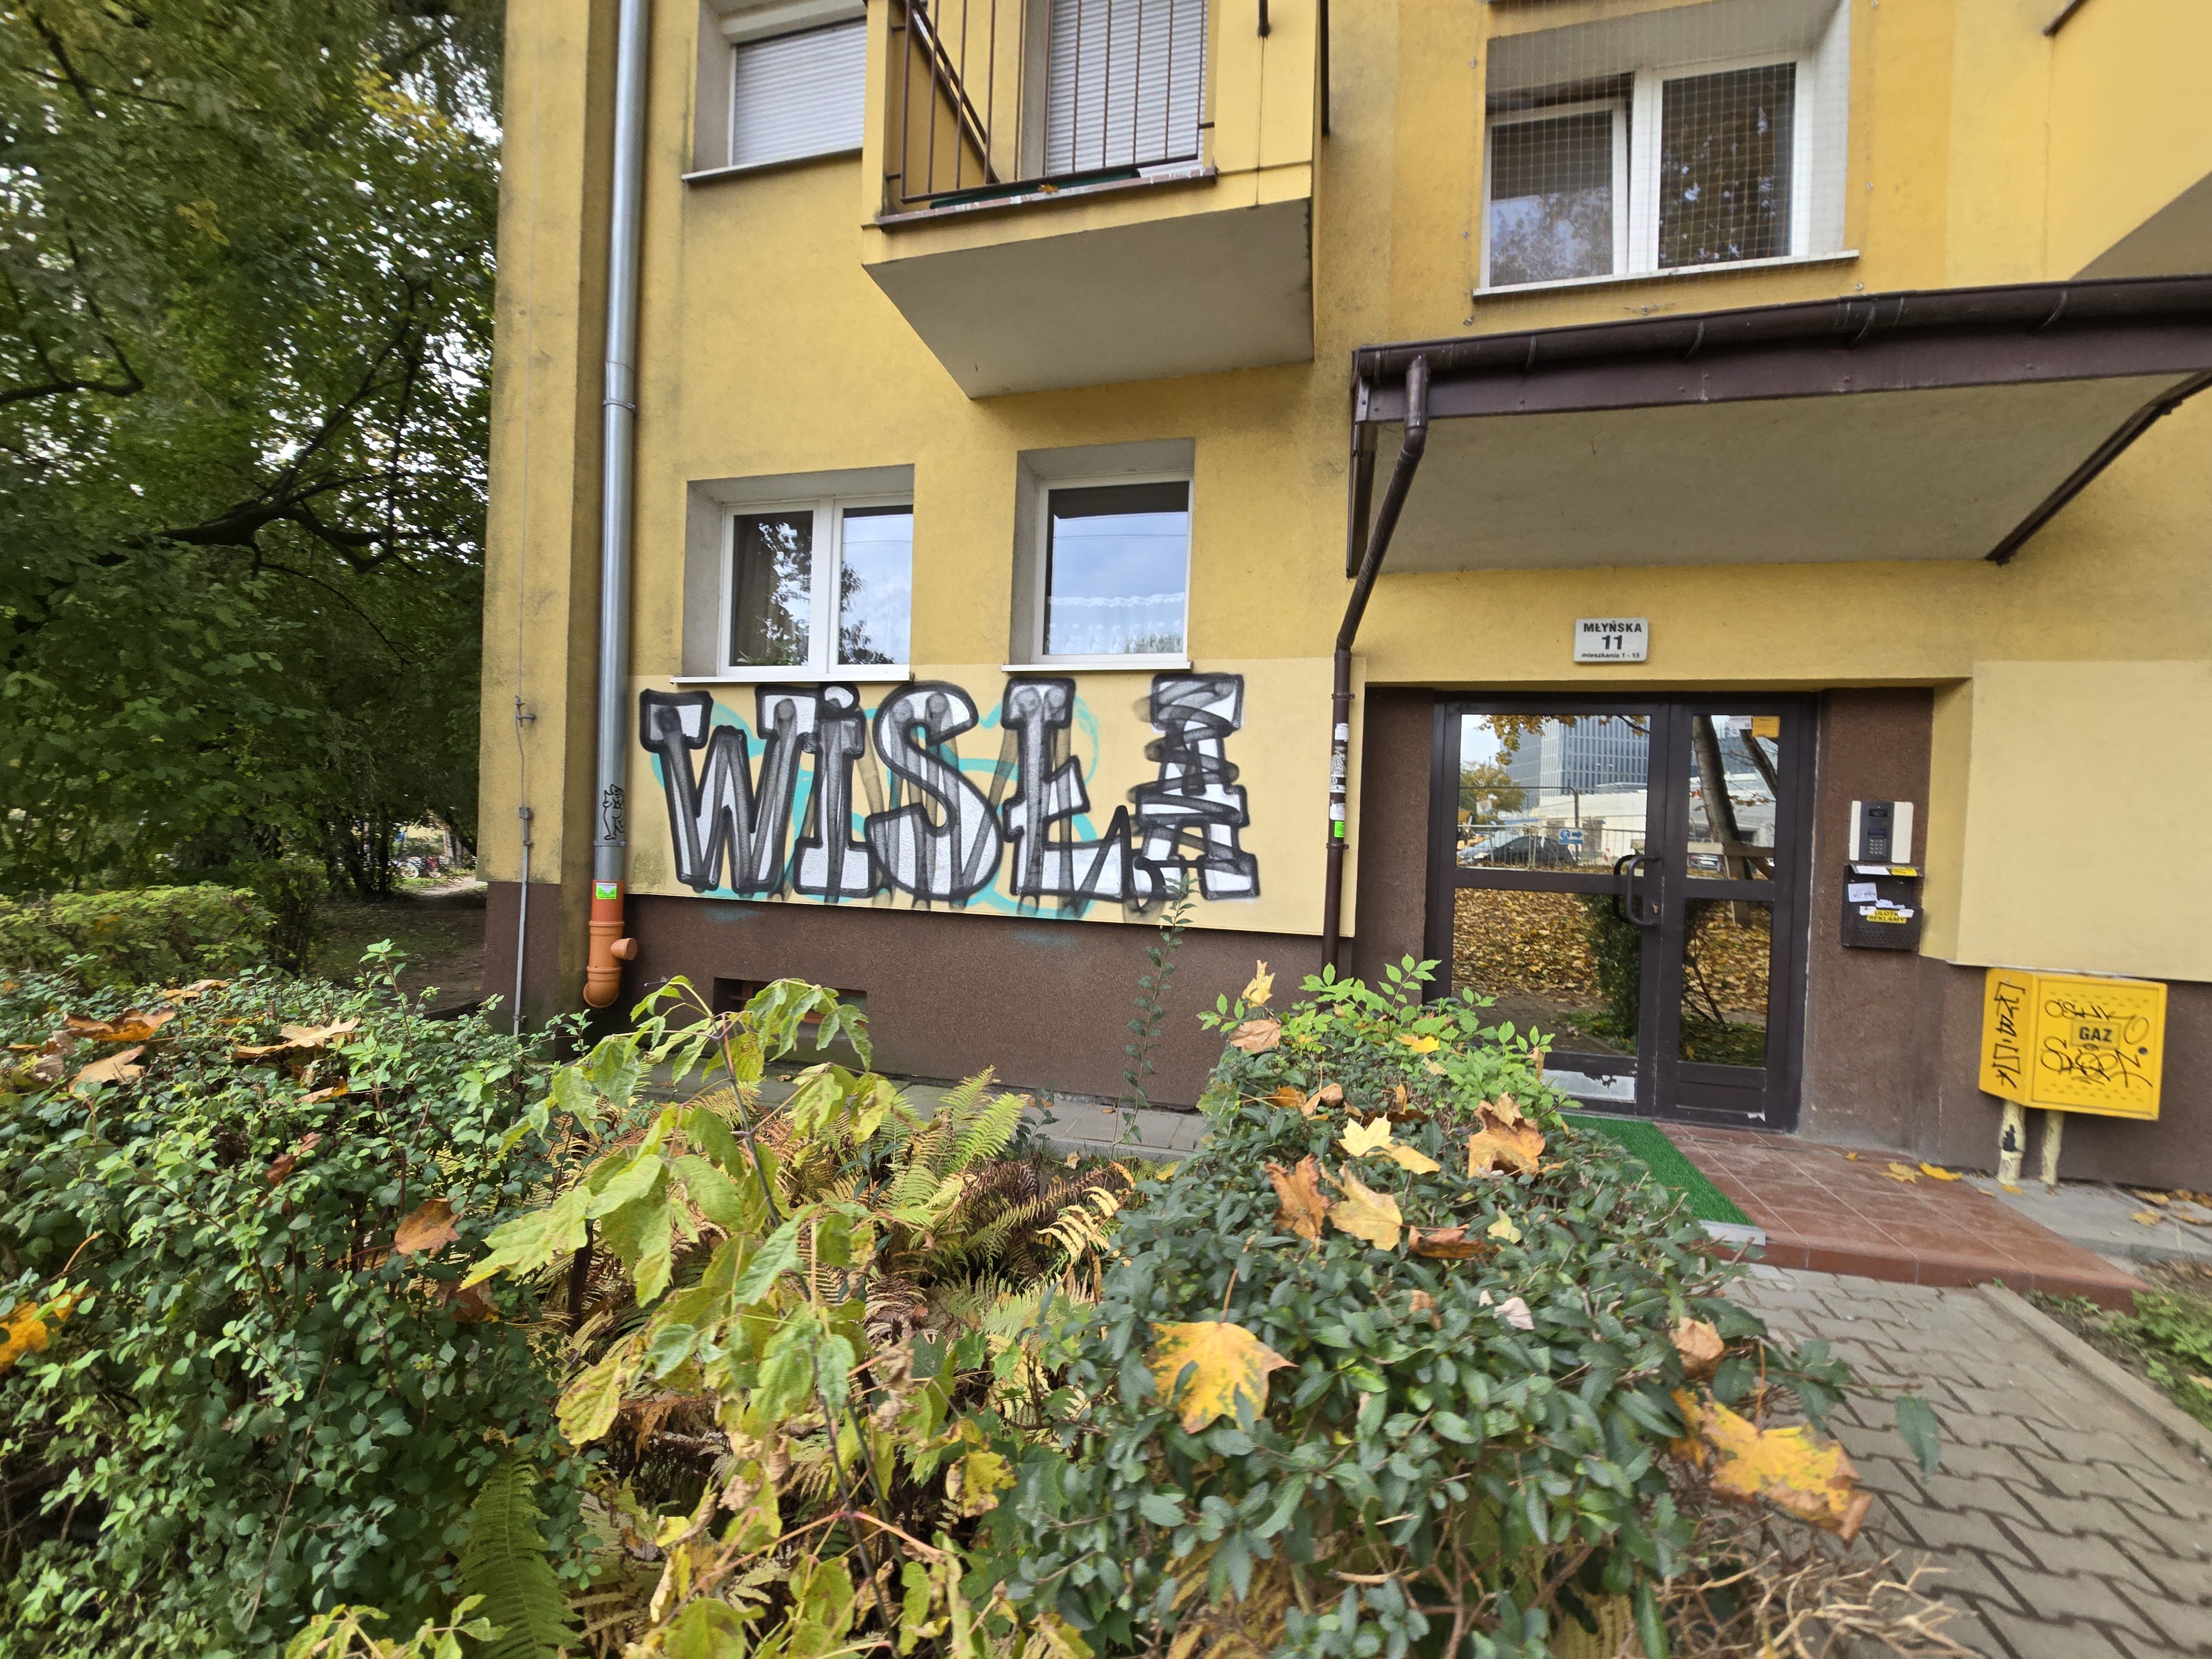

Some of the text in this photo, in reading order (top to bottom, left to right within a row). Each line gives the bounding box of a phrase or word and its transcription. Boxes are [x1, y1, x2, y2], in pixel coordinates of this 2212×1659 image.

[1583, 620, 1642, 633] MŁYŃSKA
[1601, 634, 1623, 650] 11
[2079, 1026, 2113, 1042] GAZ
